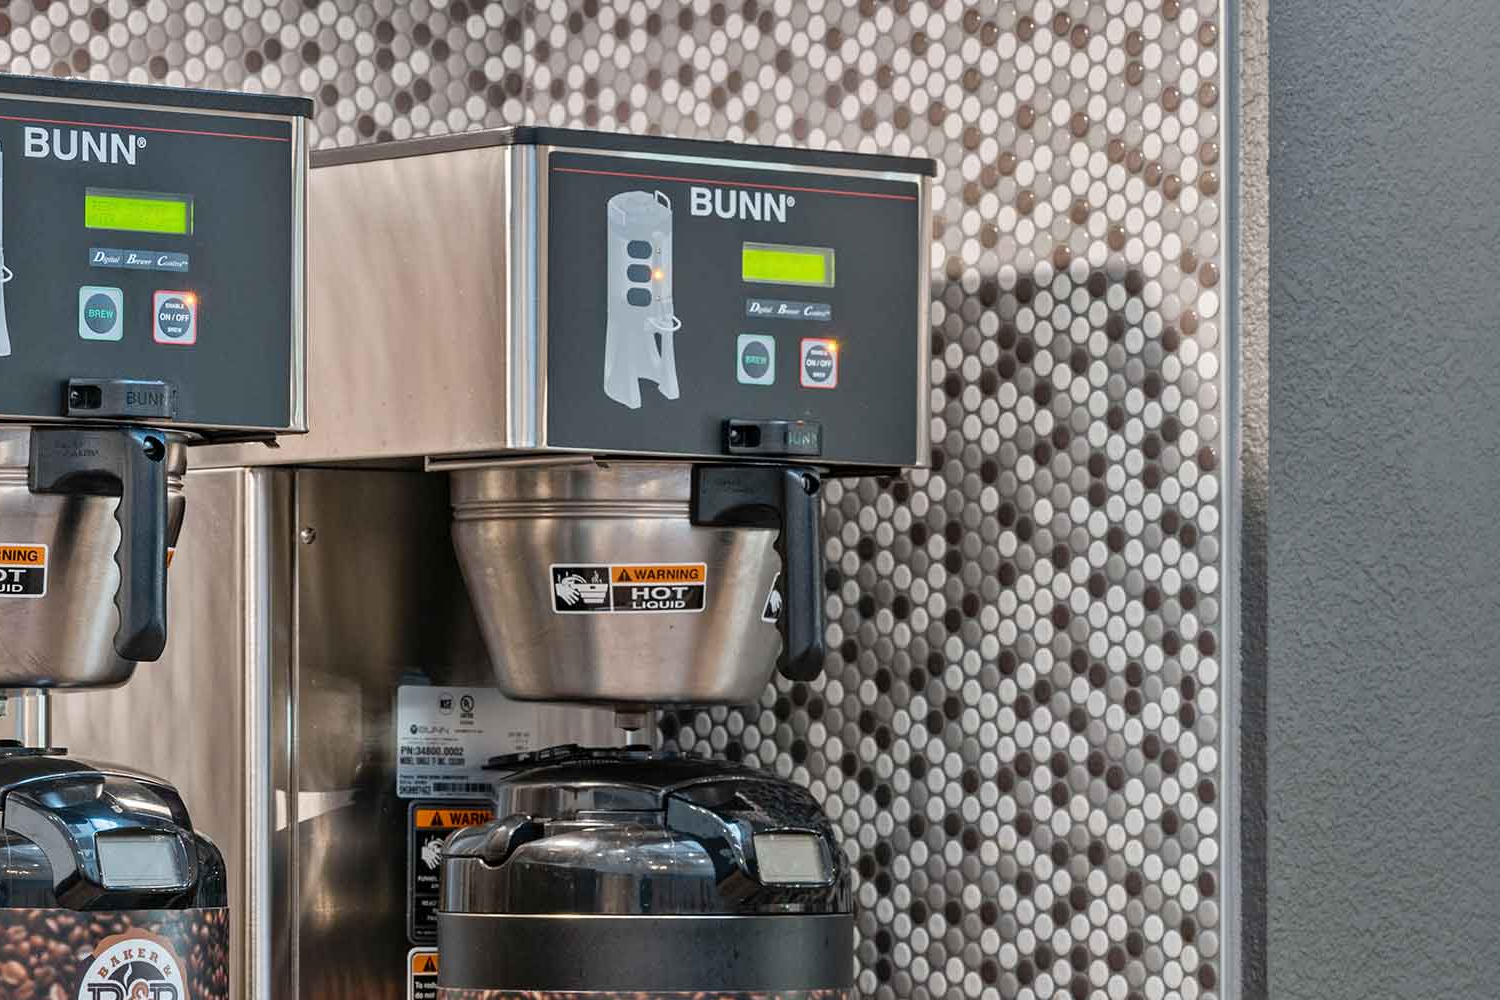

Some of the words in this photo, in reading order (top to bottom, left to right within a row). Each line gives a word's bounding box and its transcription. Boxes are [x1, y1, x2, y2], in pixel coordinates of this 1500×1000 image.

[88, 309, 114, 319] BREW
[634, 568, 699, 580] WARNING
[631, 586, 688, 600] HOT
[632, 600, 686, 609] LIQUID
[98, 947, 159, 978] BAKER
